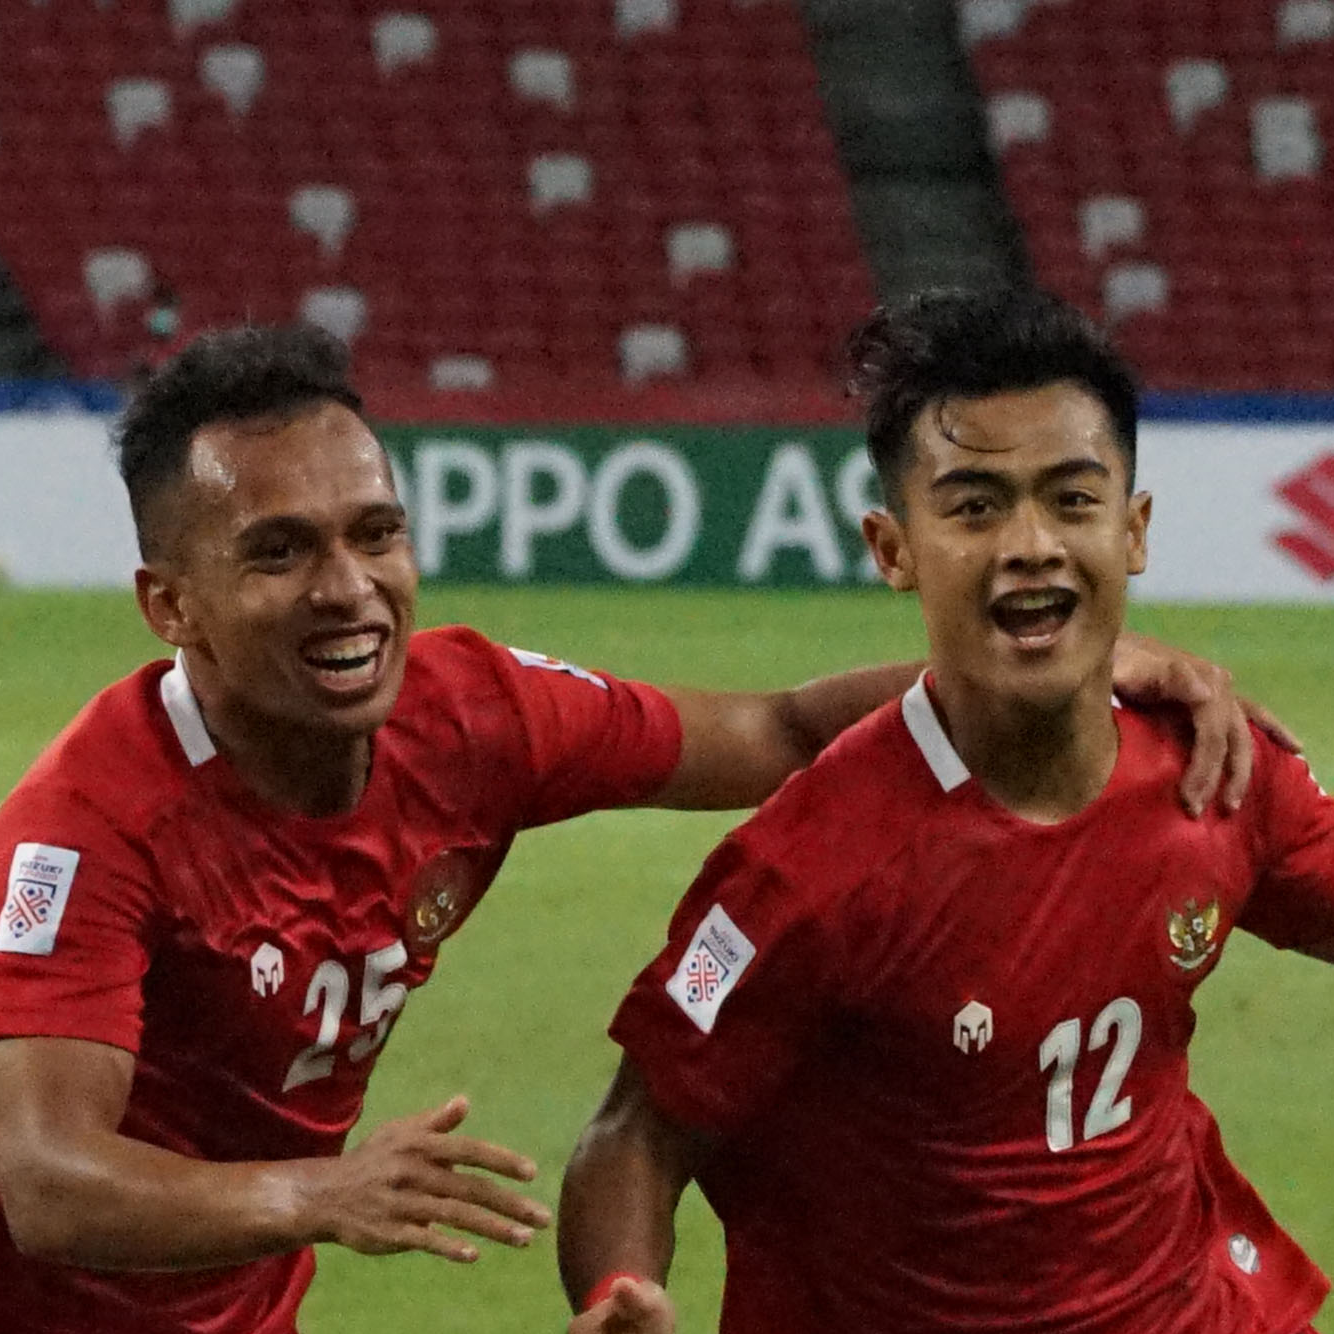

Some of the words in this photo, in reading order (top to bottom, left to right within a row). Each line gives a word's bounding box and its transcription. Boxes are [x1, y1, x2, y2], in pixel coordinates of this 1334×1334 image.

[389, 438, 700, 578] PPO
[281, 938, 408, 1093] 25
[1039, 996, 1142, 1153] 12
